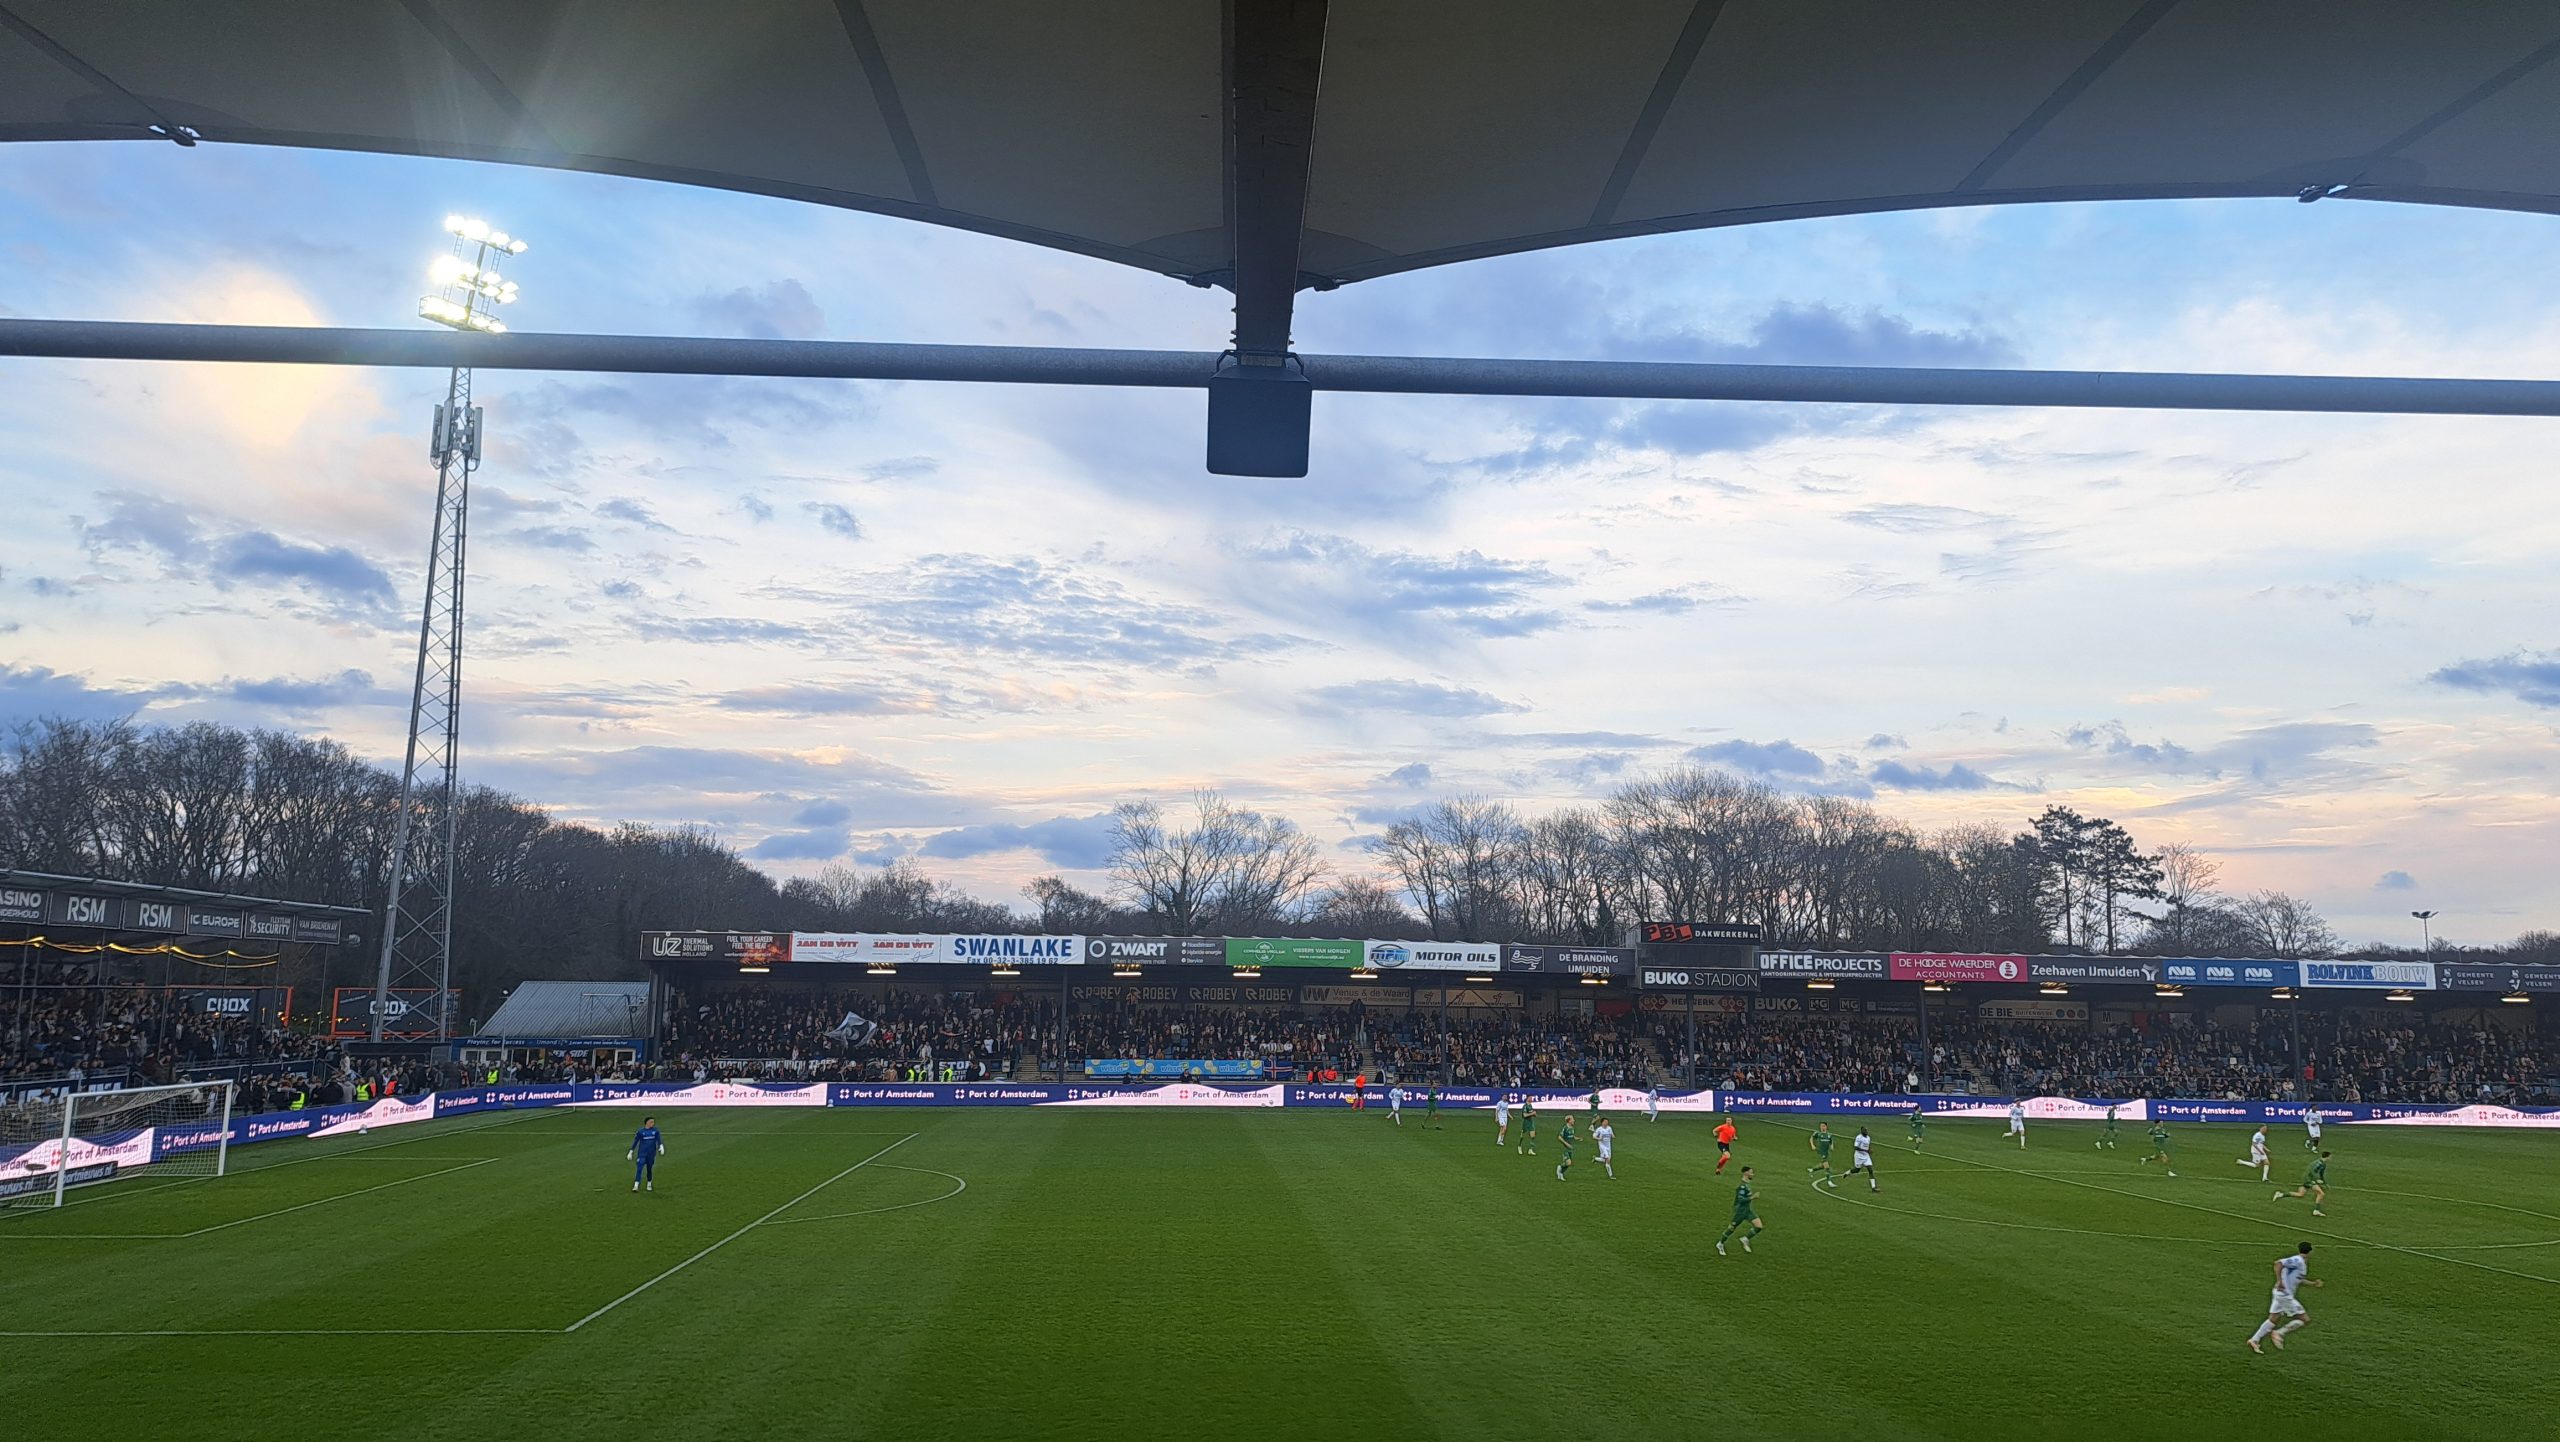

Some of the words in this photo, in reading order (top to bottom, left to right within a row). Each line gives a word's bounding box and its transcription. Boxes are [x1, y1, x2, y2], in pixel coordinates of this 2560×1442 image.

[67, 896, 106, 923] RSM
[138, 903, 172, 928] RSM
[202, 915, 240, 928] EUROPE
[257, 923, 290, 935] SECURITY
[1695, 930, 1748, 938] DAKWERKEN
[683, 944, 713, 952] SOLUTIONS
[954, 938, 1072, 957] SWANLAKE
[1110, 943, 1167, 956] ZWART
[1415, 952, 1462, 961] MOTOR
[1466, 953, 1496, 962] OILS
[1559, 953, 1571, 962] DE
[1572, 954, 1618, 963] BRANDING
[1899, 958, 1912, 967] DE
[1914, 959, 1947, 968] HOOGE
[1949, 959, 1996, 969] WAERDER
[1568, 965, 1610, 974] IJMUIDEN
[1915, 970, 1985, 979] ACCOUNTANTS
[2031, 965, 2085, 976] Zeehaven
[2089, 966, 2140, 977] IJmuiden
[1694, 973, 1758, 987] STADION
[1142, 987, 1178, 1000] ROBEY
[1202, 987, 1238, 1000] ROBEY
[1258, 988, 1294, 1001] ROBEY
[1333, 988, 1359, 997] Venus
[1362, 989, 1367, 998] &
[1370, 989, 1381, 998] de
[1383, 989, 1410, 998] Waard
[206, 998, 250, 1013] CBOX
[1980, 1007, 1994, 1016] DE
[1996, 1007, 2013, 1017] BIE
[499, 1092, 515, 1101] Port
[518, 1091, 527, 1100] of
[527, 1090, 572, 1100] Amsterdam
[608, 1090, 628, 1099] Port
[630, 1090, 641, 1099] of
[728, 1090, 746, 1098] Port
[749, 1090, 761, 1098] of
[761, 1090, 810, 1098] Amsterdam
[854, 1090, 872, 1098] Port
[873, 1090, 885, 1098] of
[886, 1090, 934, 1098] Amsterdam
[969, 1090, 987, 1098] Port
[989, 1090, 1000, 1098] of
[1000, 1090, 1048, 1098] Amsterdam
[1081, 1090, 1100, 1098] Port
[1101, 1090, 1112, 1098] of
[1192, 1091, 1210, 1099] Port
[1212, 1091, 1223, 1099] of
[1224, 1091, 1269, 1099] Amsterdam
[1308, 1091, 1326, 1100] Port
[1328, 1091, 1337, 1100] of
[1445, 1092, 1490, 1101] Amsterdam
[1522, 1094, 1539, 1102] Prt
[1541, 1093, 1549, 1102] of
[1626, 1095, 1642, 1103] Port
[444, 1099, 453, 1108] Port
[453, 1098, 459, 1107] of
[1737, 1097, 1755, 1105] Port
[1757, 1097, 1766, 1105] of
[1766, 1098, 1812, 1106] Amsterdam
[1843, 1099, 1861, 1107] Port
[1863, 1099, 1872, 1107] of
[1873, 1099, 1918, 1108] Amsterdam
[1951, 1101, 1968, 1110] Port
[1970, 1101, 1979, 1110] of
[389, 1106, 399, 1116] Port
[400, 1104, 406, 1114] of
[2058, 1104, 2075, 1112] Port
[2077, 1104, 2085, 1112] of
[2171, 1106, 2188, 1114] Port
[2190, 1106, 2200, 1114] of
[2201, 1106, 2247, 1115] Amsterdam
[2278, 1108, 2296, 1116] Port
[2297, 1108, 2306, 1116] of
[328, 1114, 340, 1124] Port
[339, 1111, 347, 1122] of
[2384, 1110, 2402, 1118] Port
[2404, 1110, 2412, 1118] of
[2415, 1110, 2459, 1119] Amsterdam
[2491, 1112, 2509, 1120] Port
[2511, 1112, 2520, 1120] of
[258, 1124, 271, 1135] Port
[272, 1122, 280, 1132] of
[279, 1119, 310, 1132] Amsterdam
[174, 1135, 189, 1148] Port
[190, 1132, 199, 1144] of
[200, 1130, 236, 1143] Amsteram
[85, 1145, 94, 1159] of
[95, 1143, 138, 1158] Amsterdam
